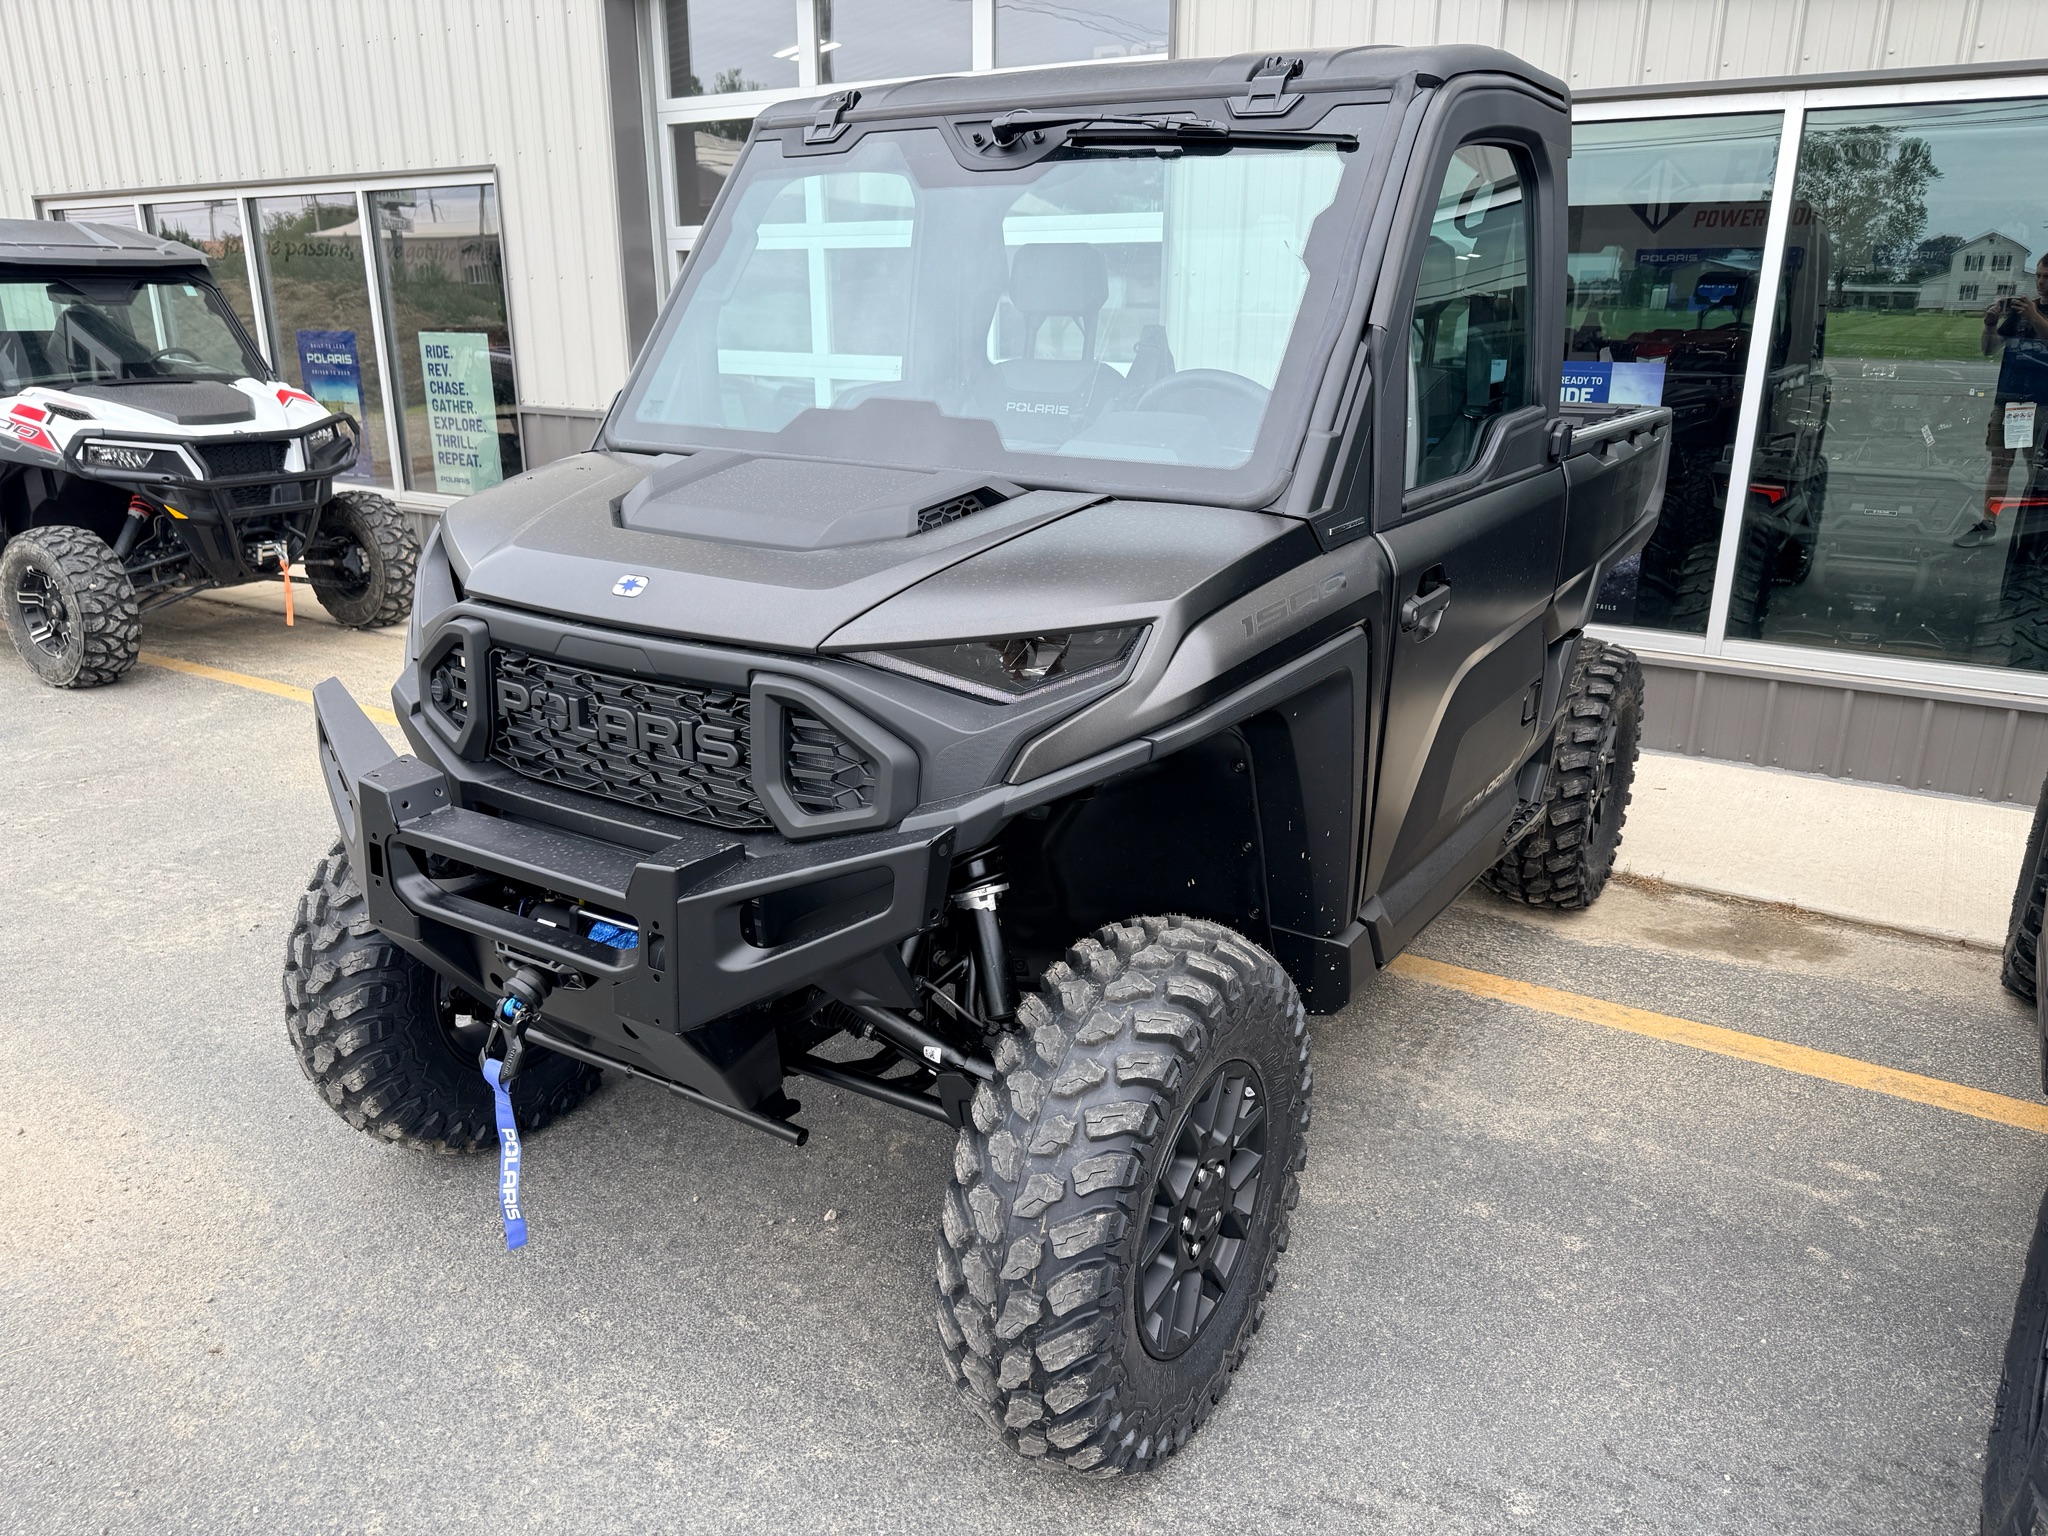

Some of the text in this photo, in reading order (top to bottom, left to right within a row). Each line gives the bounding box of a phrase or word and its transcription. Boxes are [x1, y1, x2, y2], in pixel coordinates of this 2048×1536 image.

[285, 239, 354, 262] passion,
[1640, 252, 1698, 263] POLARIS
[306, 353, 353, 365] POLARIS
[425, 344, 454, 359] RIDE.
[427, 363, 452, 377] REV.
[1591, 376, 1603, 385] TO
[429, 381, 469, 396] CHASE.
[432, 398, 478, 414] GATHER.
[1006, 402, 1069, 415] POLARIS
[433, 416, 487, 433] EXPLORE.
[436, 434, 478, 450] THRILL.
[438, 451, 482, 468] REPEAT.
[440, 475, 471, 485] POLARIS
[1241, 571, 1347, 639] 1500
[496, 679, 740, 768] POLARIS
[501, 1127, 522, 1221] POLARIS
